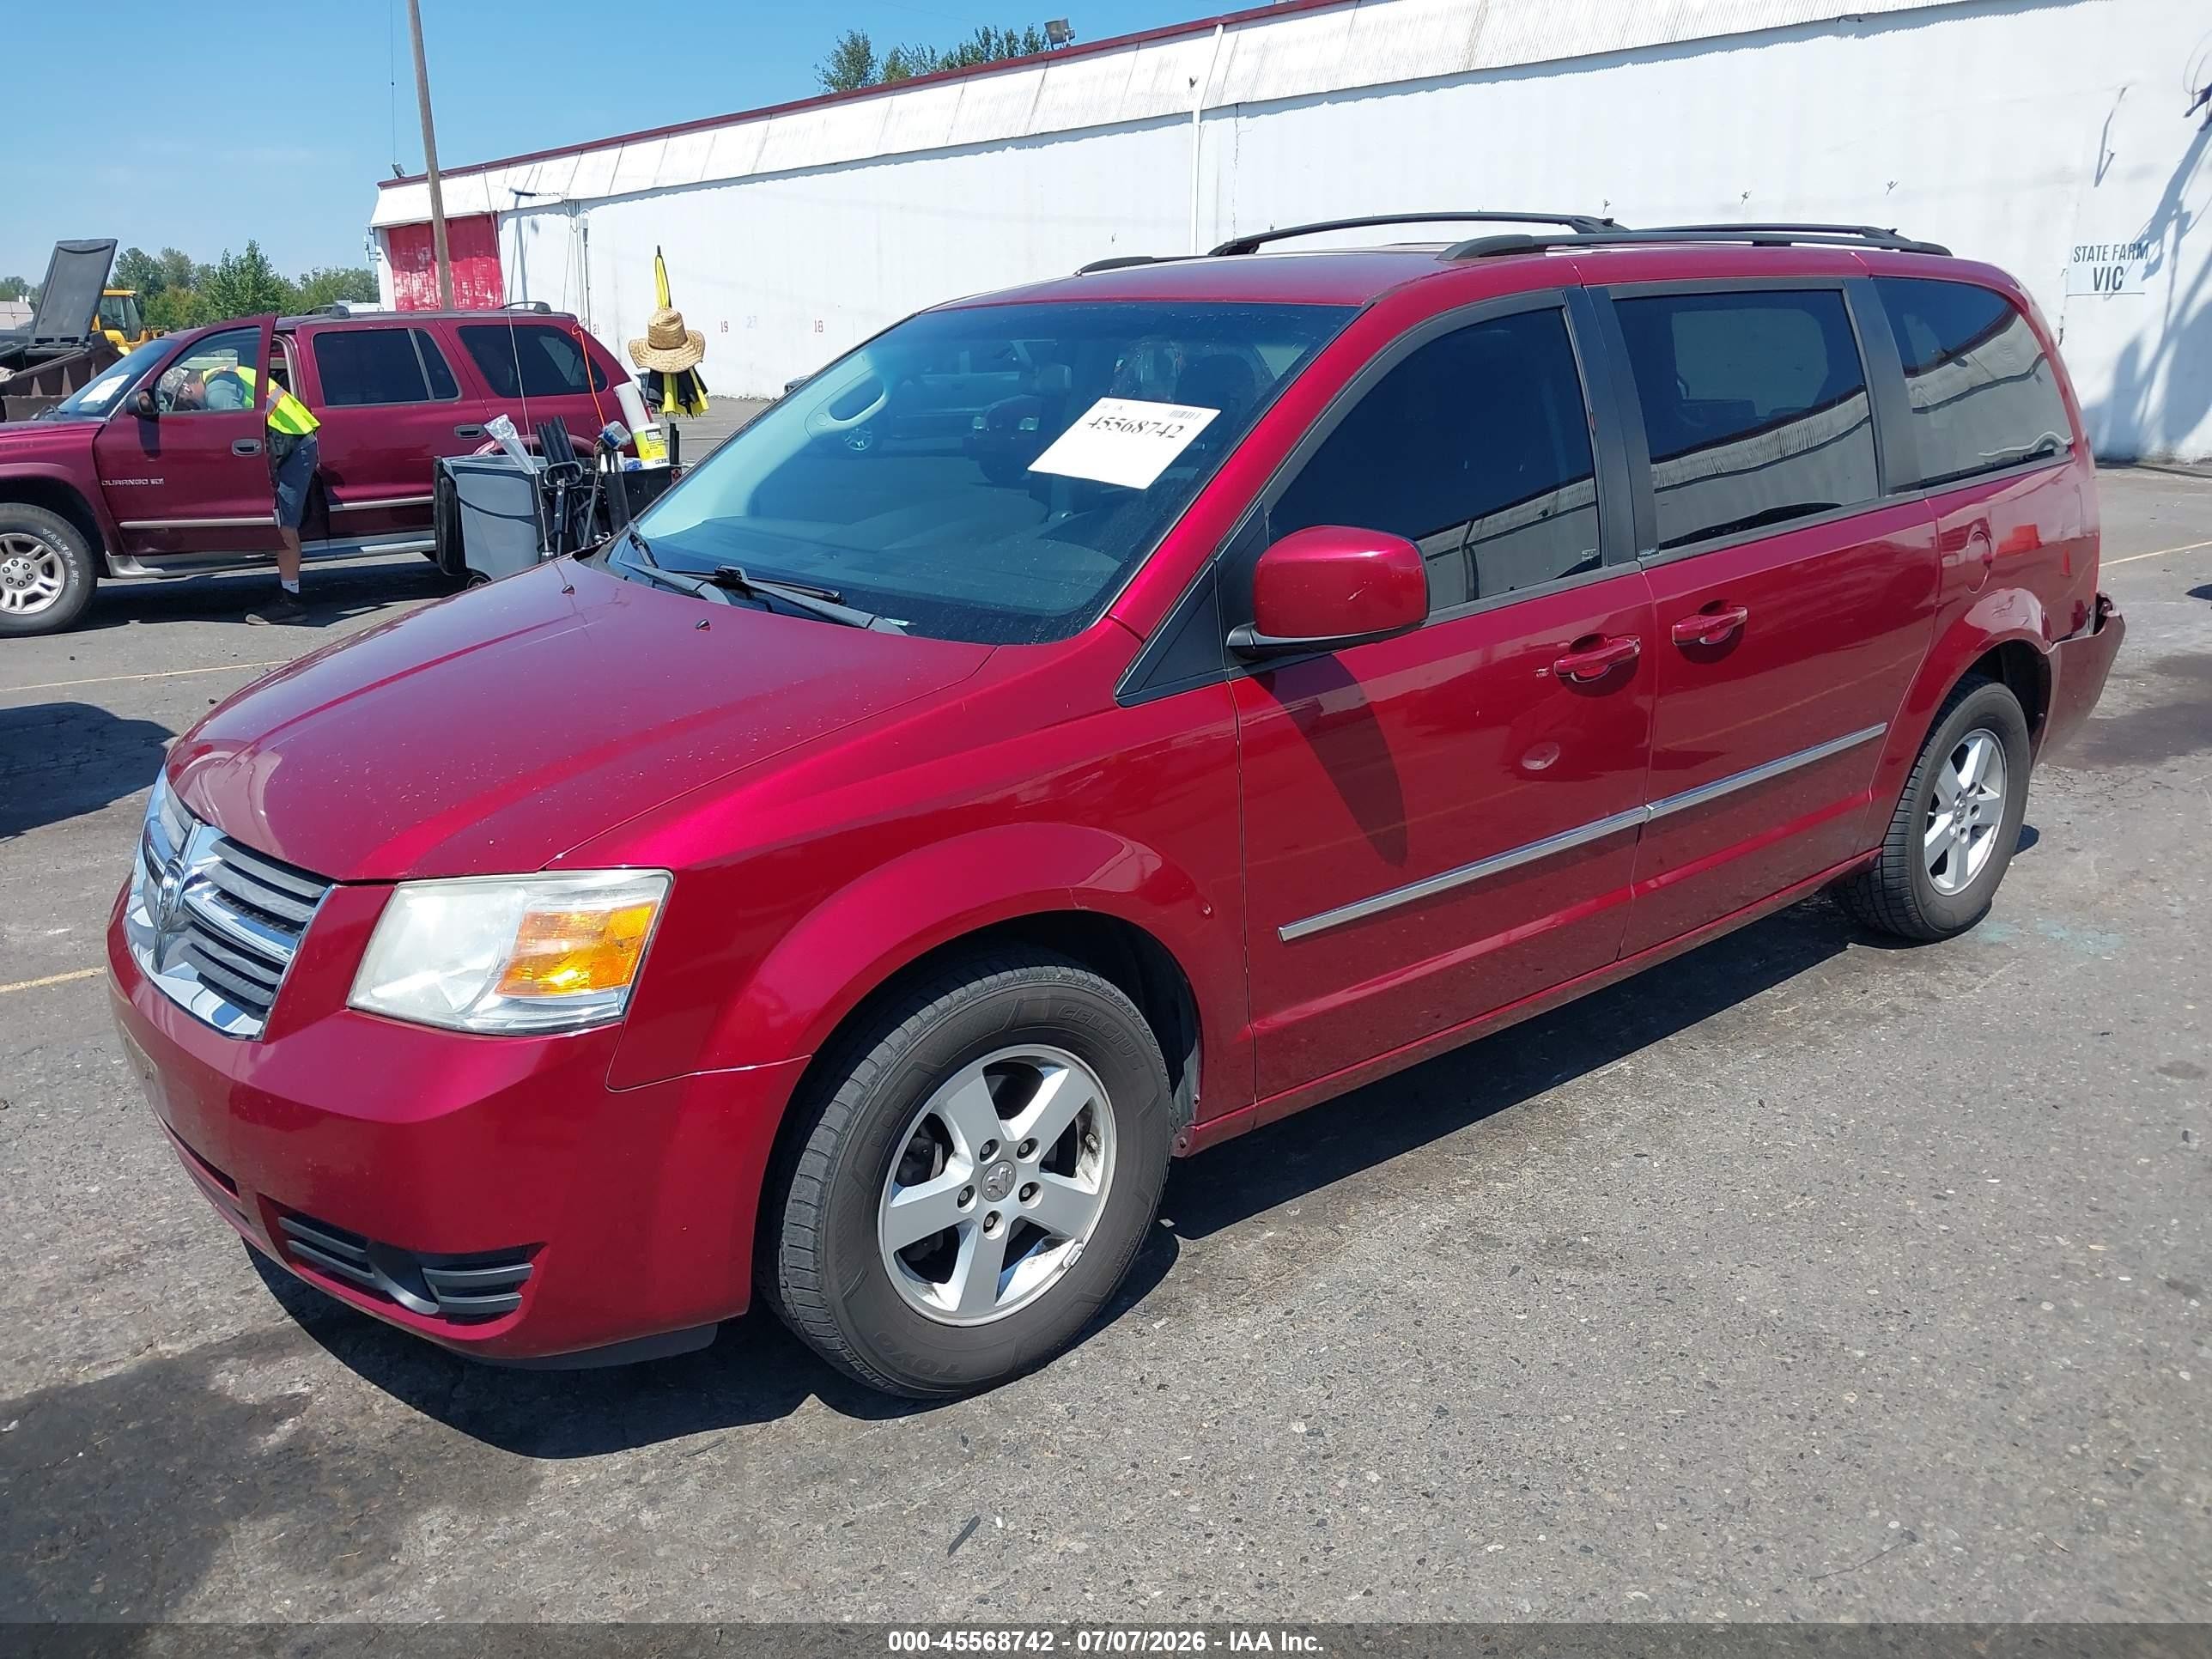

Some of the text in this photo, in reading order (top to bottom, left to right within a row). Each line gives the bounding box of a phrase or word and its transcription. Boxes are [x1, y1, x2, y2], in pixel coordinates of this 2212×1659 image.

[2073, 242, 2149, 263] STATE FARM
[2093, 265, 2124, 291] VIC
[592, 323, 600, 335] 21
[720, 320, 729, 333] 19
[813, 319, 823, 333] 18
[1087, 416, 1185, 439] 45568742
[1057, 1003, 1145, 1071] CELSIUS
